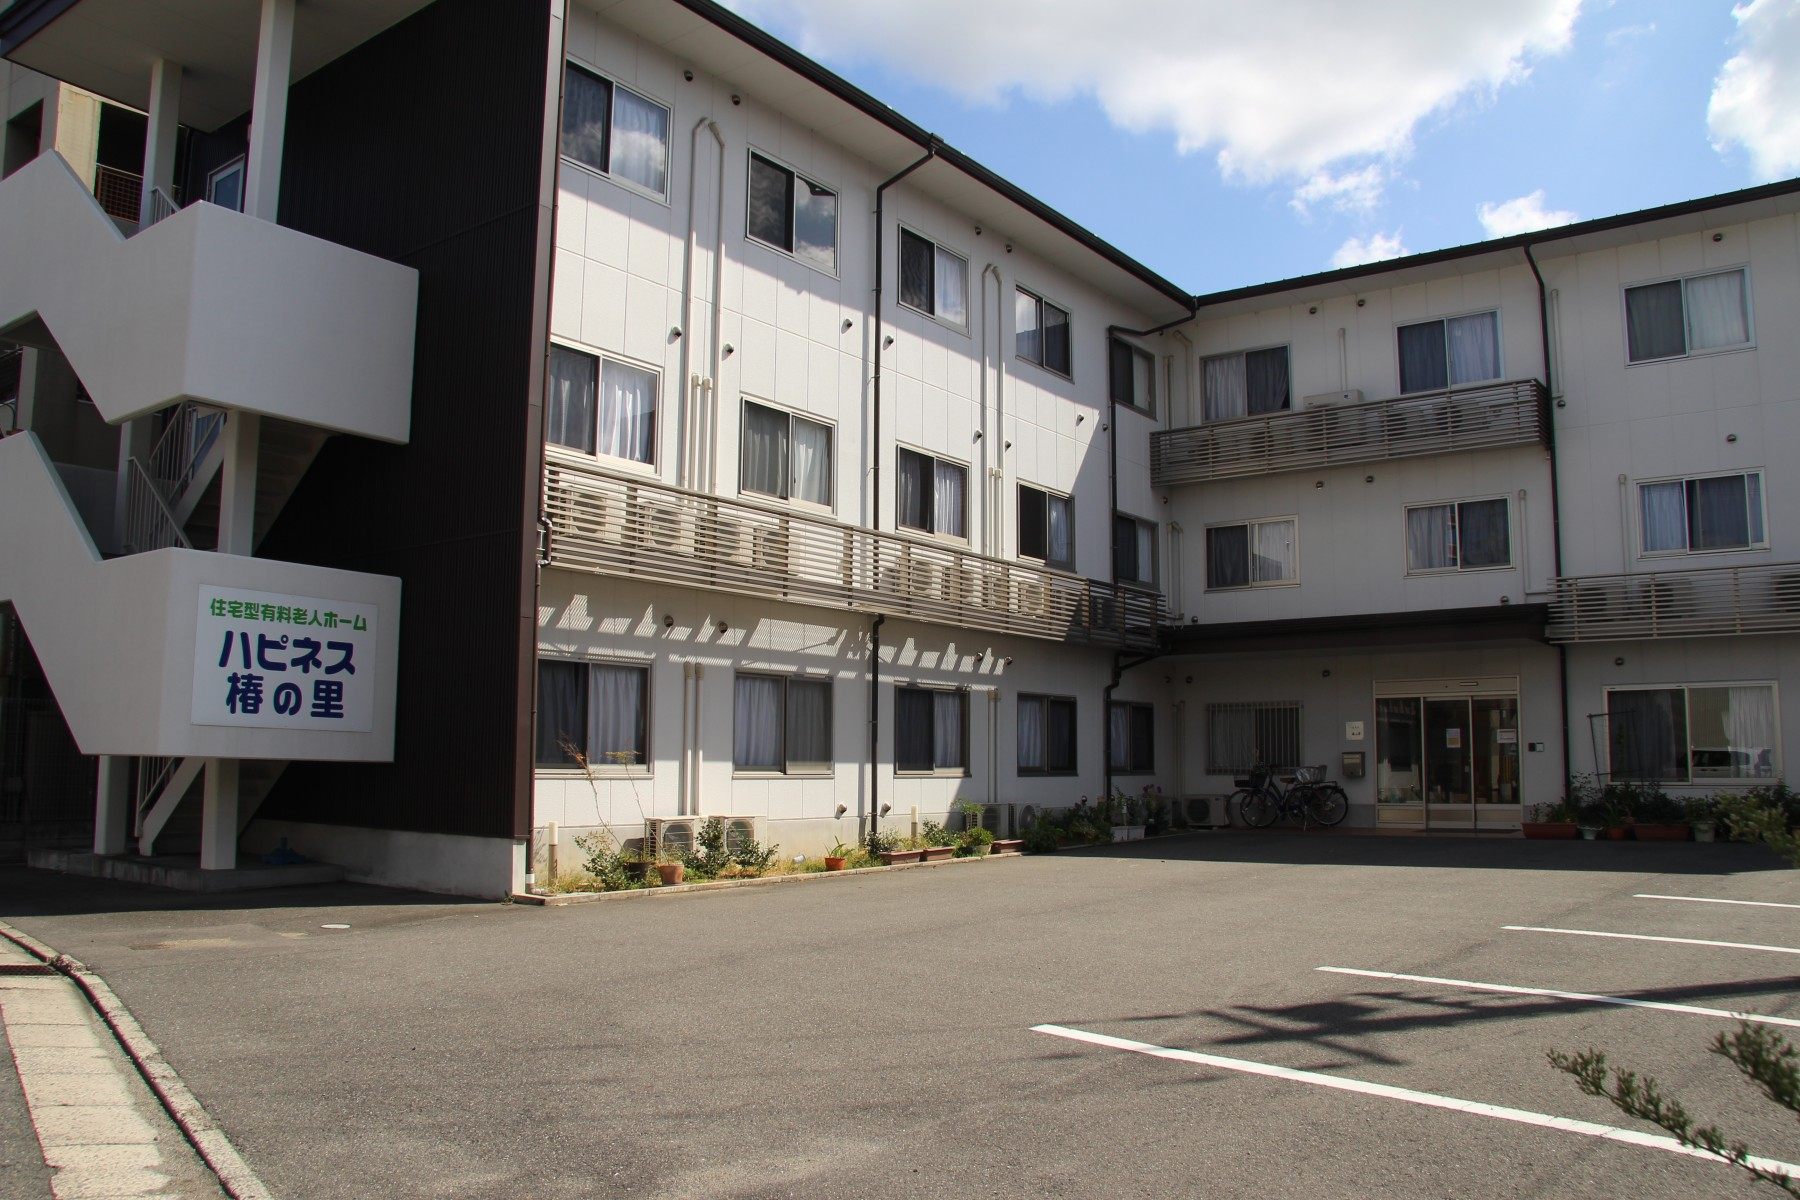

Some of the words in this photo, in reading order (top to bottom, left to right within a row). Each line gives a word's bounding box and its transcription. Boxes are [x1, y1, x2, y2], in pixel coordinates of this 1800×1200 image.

[210, 598, 367, 631] 住宅型有料老人ホーム
[218, 630, 356, 675] ハピネス
[226, 672, 344, 718] 椿の里
